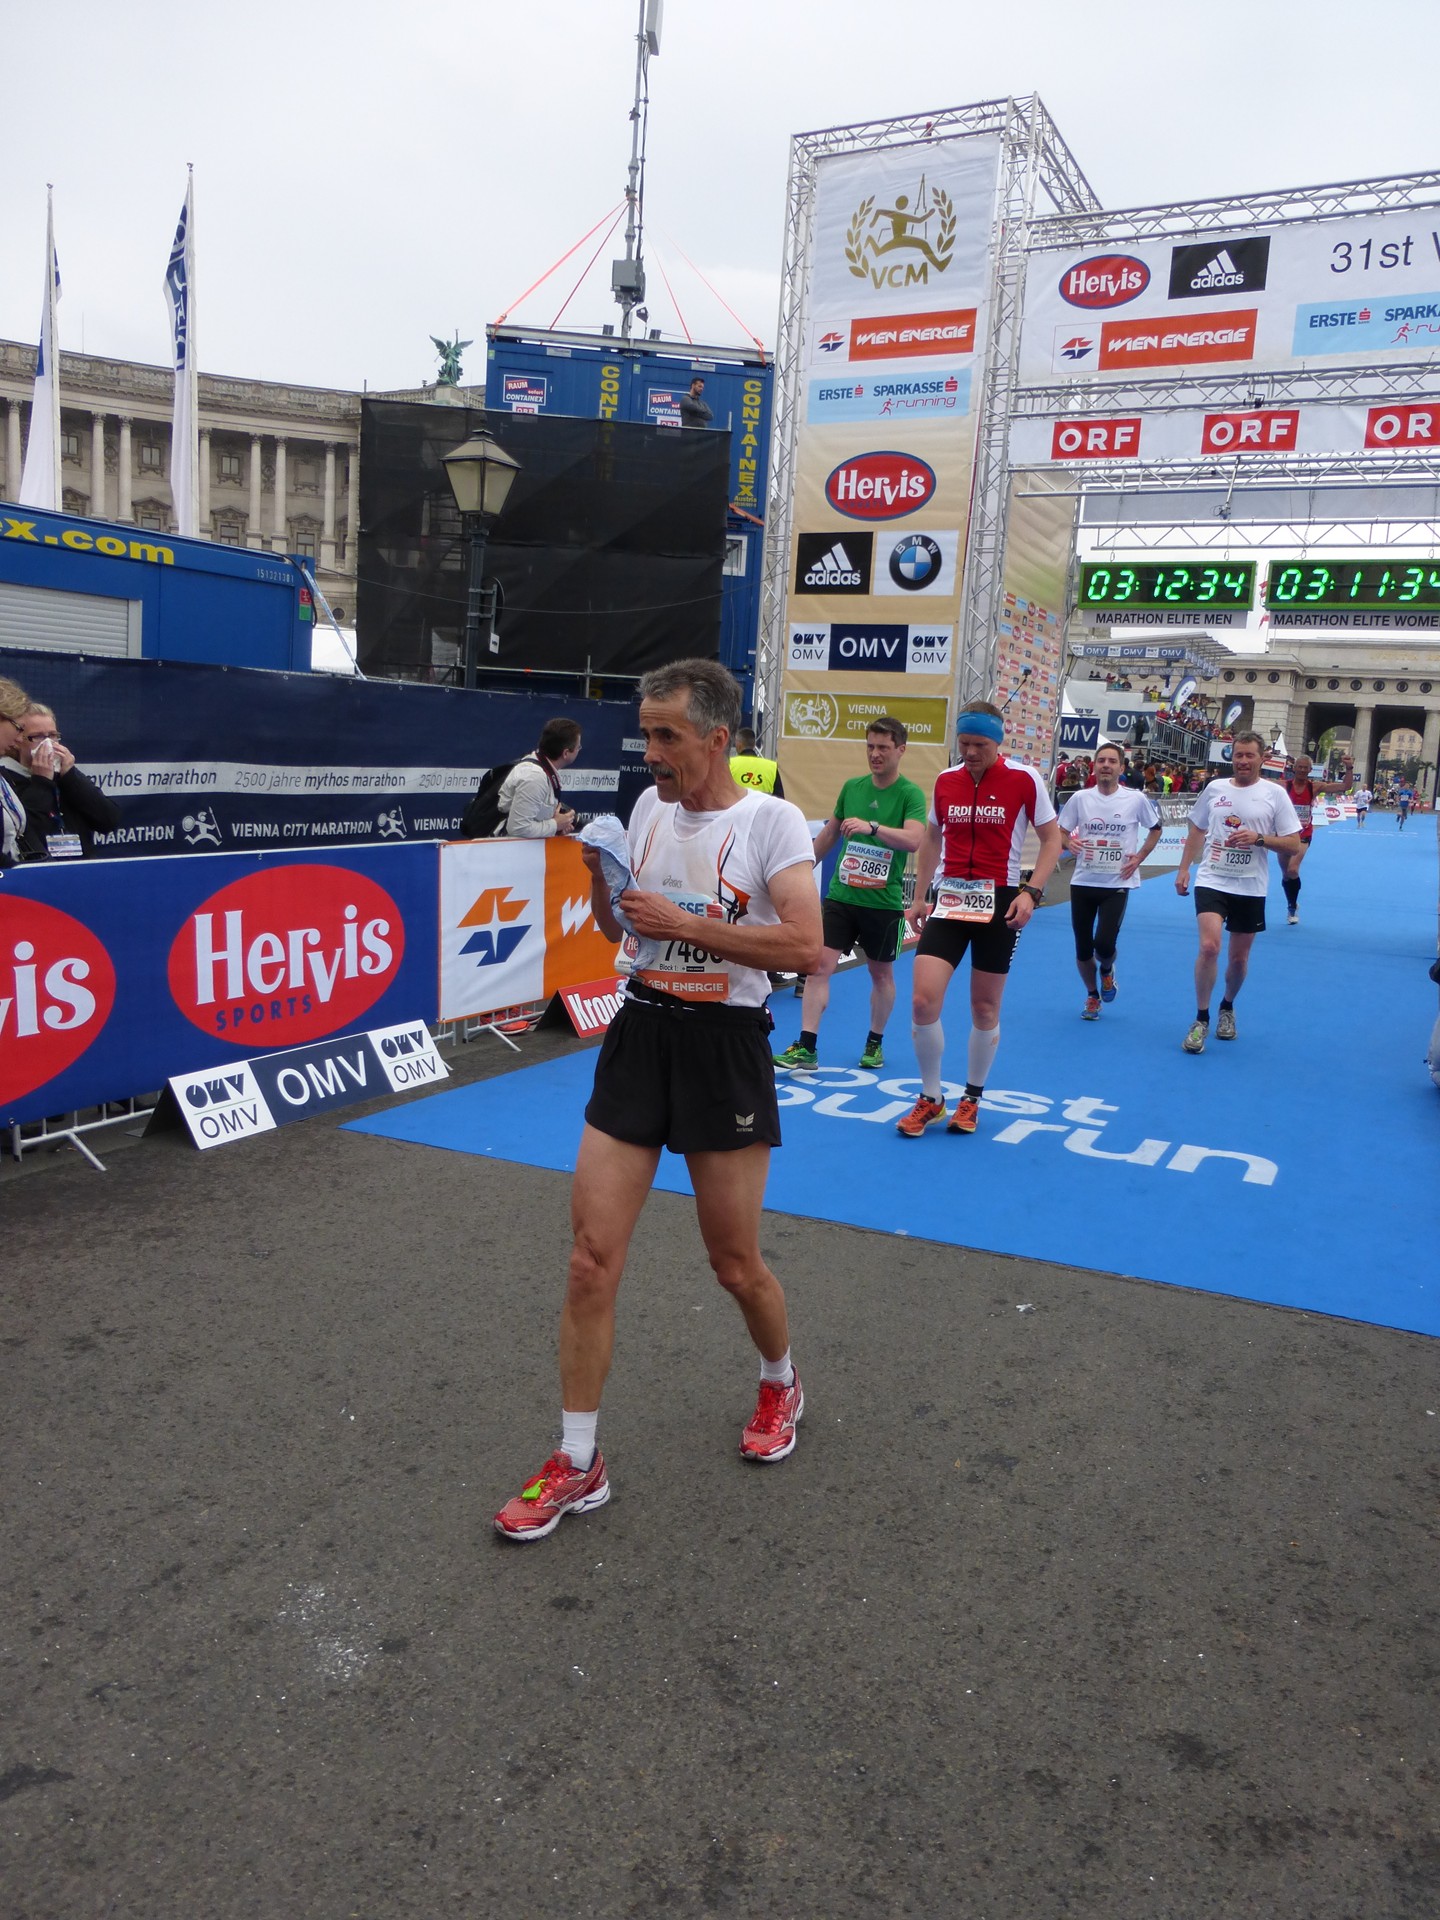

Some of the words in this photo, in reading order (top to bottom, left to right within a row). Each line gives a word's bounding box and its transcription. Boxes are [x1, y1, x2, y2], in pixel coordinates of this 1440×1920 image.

[1330, 235, 1414, 273] 31st
[870, 262, 929, 290] VCM
[1069, 267, 1142, 297] Hervis
[1190, 271, 1244, 290] adidas
[1309, 311, 1358, 328] ERSTE
[1384, 304, 1440, 322] SPARK
[855, 331, 898, 347] WIEN
[899, 324, 969, 343] ENERGIE
[1108, 335, 1159, 353] WIEN
[1161, 327, 1251, 349] ENERGIE
[508, 381, 529, 390] RAUM
[818, 387, 853, 401] ERSTE
[873, 380, 944, 397] SPARKASSE
[505, 393, 544, 403] CONTAINEX
[652, 395, 672, 404] RAUM
[896, 395, 957, 408] running
[738, 380, 763, 497] CONTAINEX
[1059, 425, 1136, 453] ORF
[1208, 418, 1292, 447] ORF
[837, 469, 926, 506] Hervis
[0, 518, 175, 565] x.com
[895, 536, 939, 555] BMW
[804, 569, 862, 586] adidas
[1095, 613, 1165, 625] MARATHON
[1166, 613, 1202, 625] ELITE
[1203, 613, 1233, 625] MEN
[1273, 614, 1350, 626] MARATHON
[1352, 615, 1391, 627] ELITE
[1394, 615, 1440, 627] WOME
[791, 648, 825, 660] OMV
[838, 637, 901, 659] OMV
[911, 651, 948, 664] OMV
[1086, 647, 1106, 656] OMV
[1123, 648, 1144, 657] OMV
[1161, 649, 1182, 657] OMV
[848, 704, 888, 715] VIENNA
[1060, 724, 1096, 742] MV
[147, 768, 217, 786] marathon
[234, 770, 267, 788] 2500
[267, 771, 302, 791] jahre
[304, 773, 349, 791] mythos
[351, 773, 406, 787] marathon
[419, 773, 442, 788] 2500
[442, 773, 468, 790] jahre
[947, 804, 1006, 819] ERDINGER
[93, 825, 175, 846] MARATHON
[231, 822, 280, 838] VIENNA
[283, 822, 310, 837] CITY
[311, 820, 373, 837] MARATHON
[413, 817, 450, 831] VIENNA
[1099, 851, 1122, 862] 716D
[1225, 852, 1252, 865] 1233D
[861, 860, 888, 877] 6863
[964, 894, 993, 909] 4262
[193, 904, 393, 1007] Hervis
[659, 963, 674, 971] Block
[0, 940, 96, 1038] is
[672, 981, 724, 992] ENERGIE
[215, 993, 313, 1032] SPORTS
[276, 1050, 367, 1106] OMV
[393, 1056, 438, 1084] OMV
[199, 1103, 257, 1139] OMV
